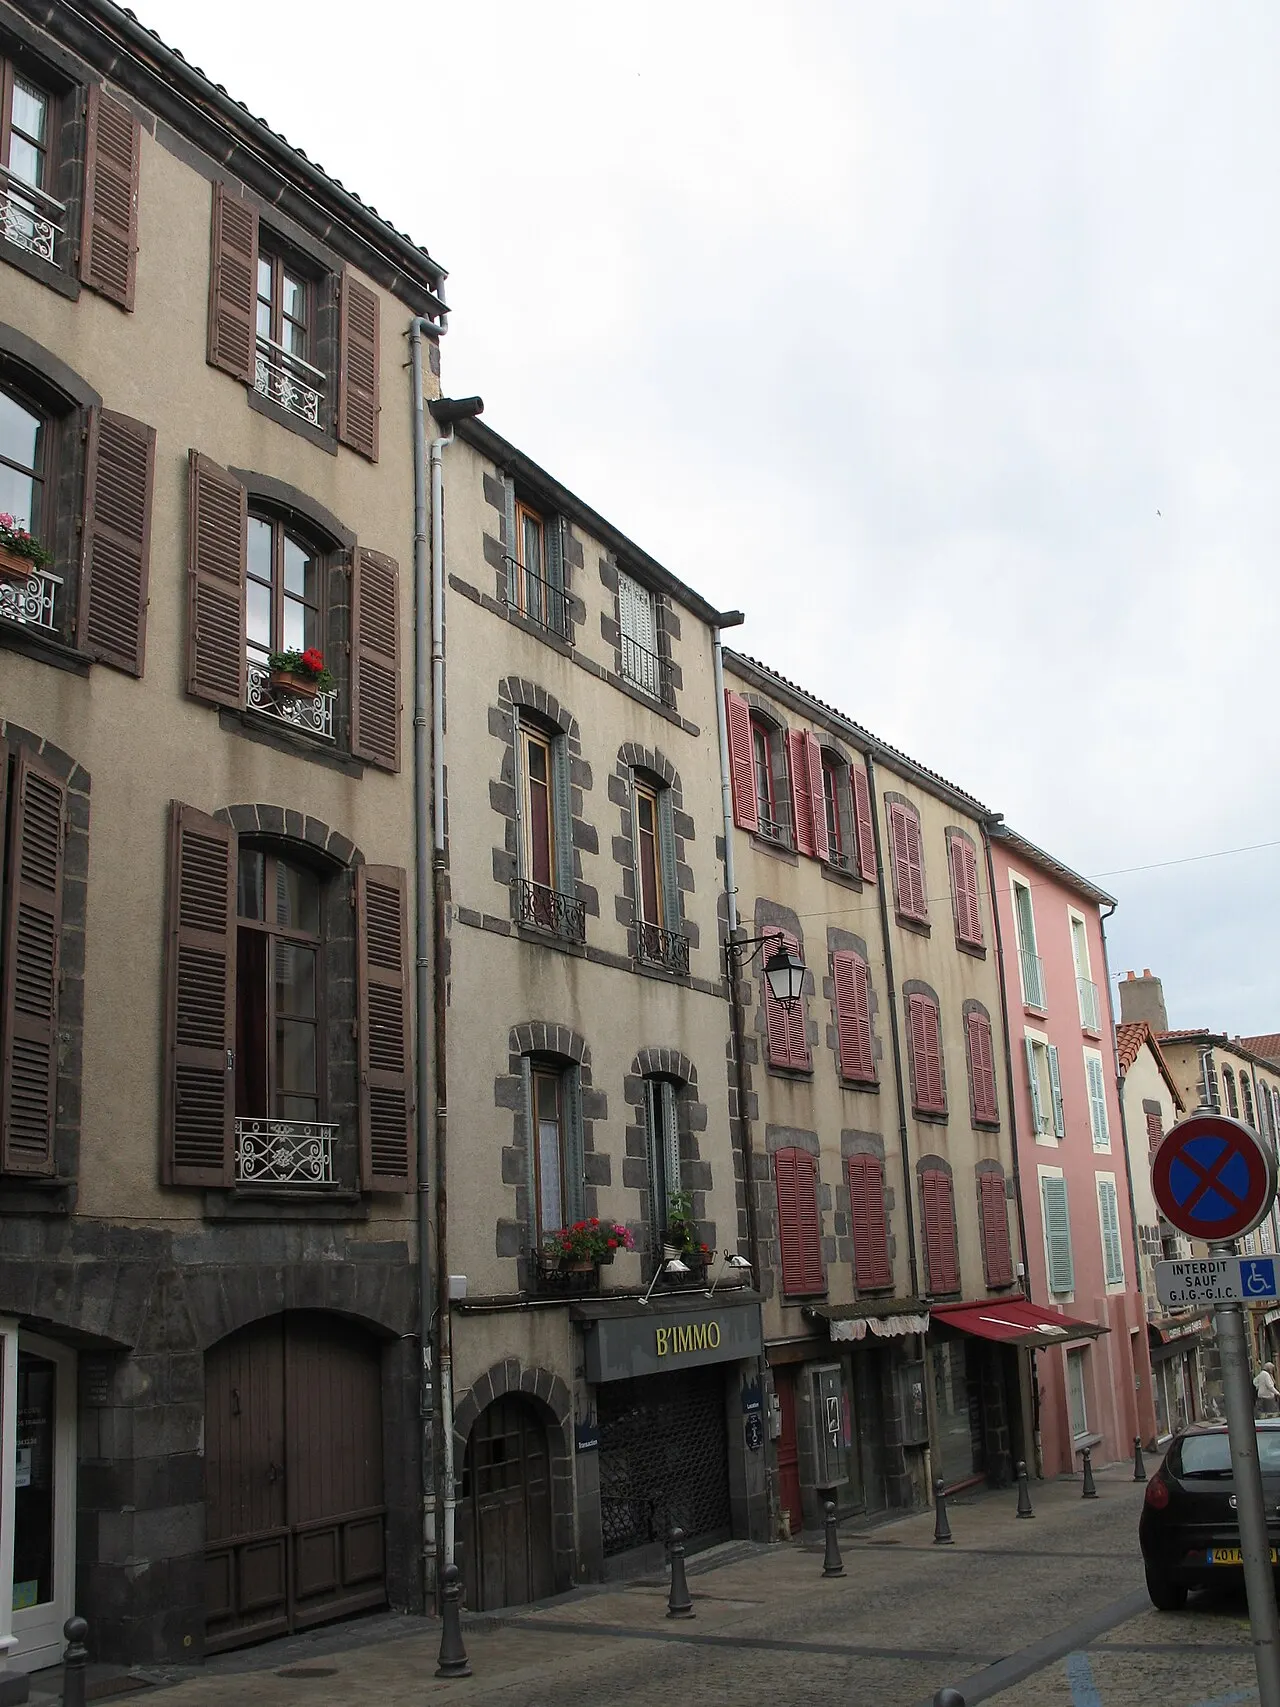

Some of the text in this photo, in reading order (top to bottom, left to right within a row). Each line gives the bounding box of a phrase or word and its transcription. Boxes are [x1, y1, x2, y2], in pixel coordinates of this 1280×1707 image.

[1172, 1261, 1227, 1275] INTERDIT
[1185, 1275, 1217, 1287] SAUF
[1169, 1288, 1237, 1301] G.I.G.-G.I.C.
[656, 1321, 721, 1356] B'IMMO
[578, 1439, 598, 1449] Transaction
[1214, 1549, 1234, 1561] 401
